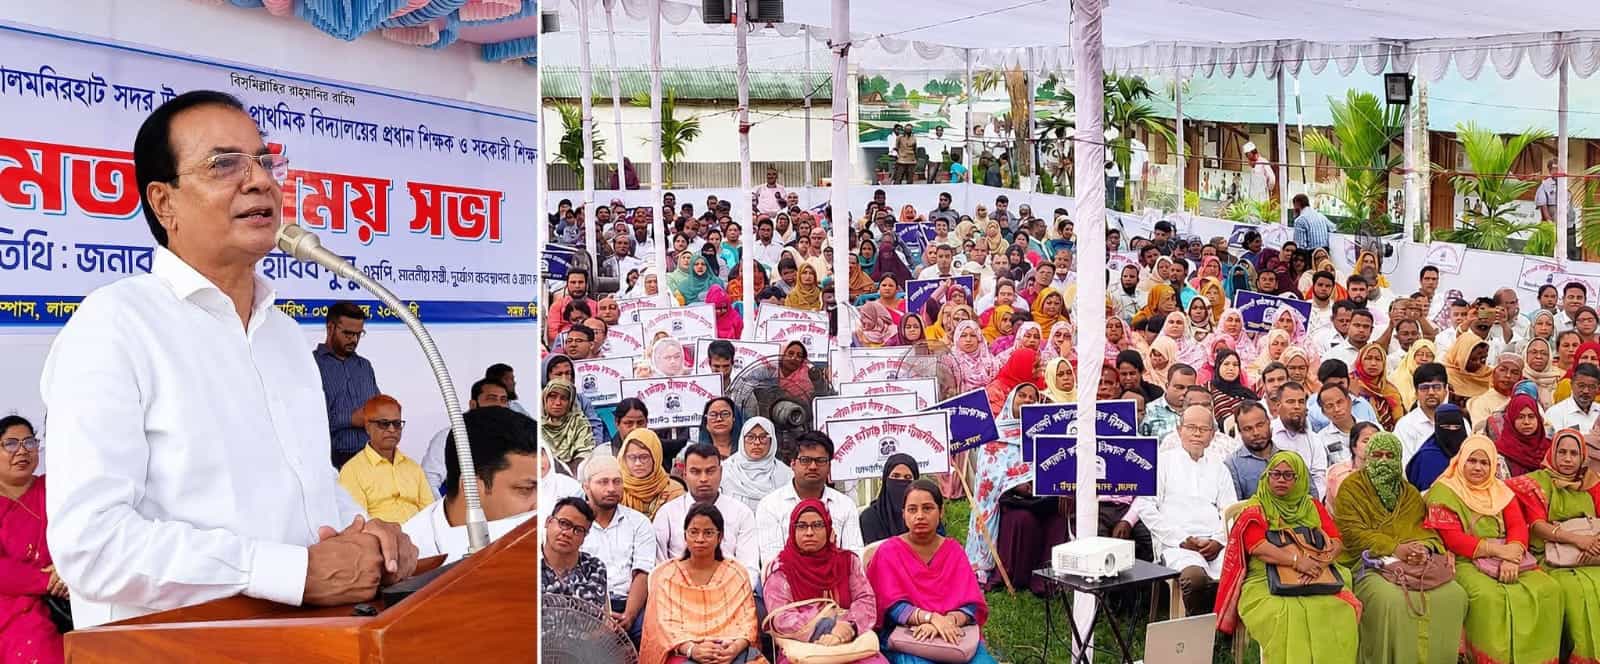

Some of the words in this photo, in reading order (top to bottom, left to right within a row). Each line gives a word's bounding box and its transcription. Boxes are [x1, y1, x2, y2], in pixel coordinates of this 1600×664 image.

[0, 65, 107, 107] ালমনিরহাট
[112, 84, 154, 112] সদর
[311, 108, 377, 143] বিদ্যালয়ের
[383, 125, 413, 147] প্রধান
[418, 124, 454, 150] শিক্ষক
[459, 138, 468, 153] ও
[472, 136, 511, 164] সহকারী
[514, 139, 537, 165] শিক্ষ
[406, 181, 503, 243] সভা
[0, 226, 54, 271] তিথি
[75, 243, 154, 274] জনাব
